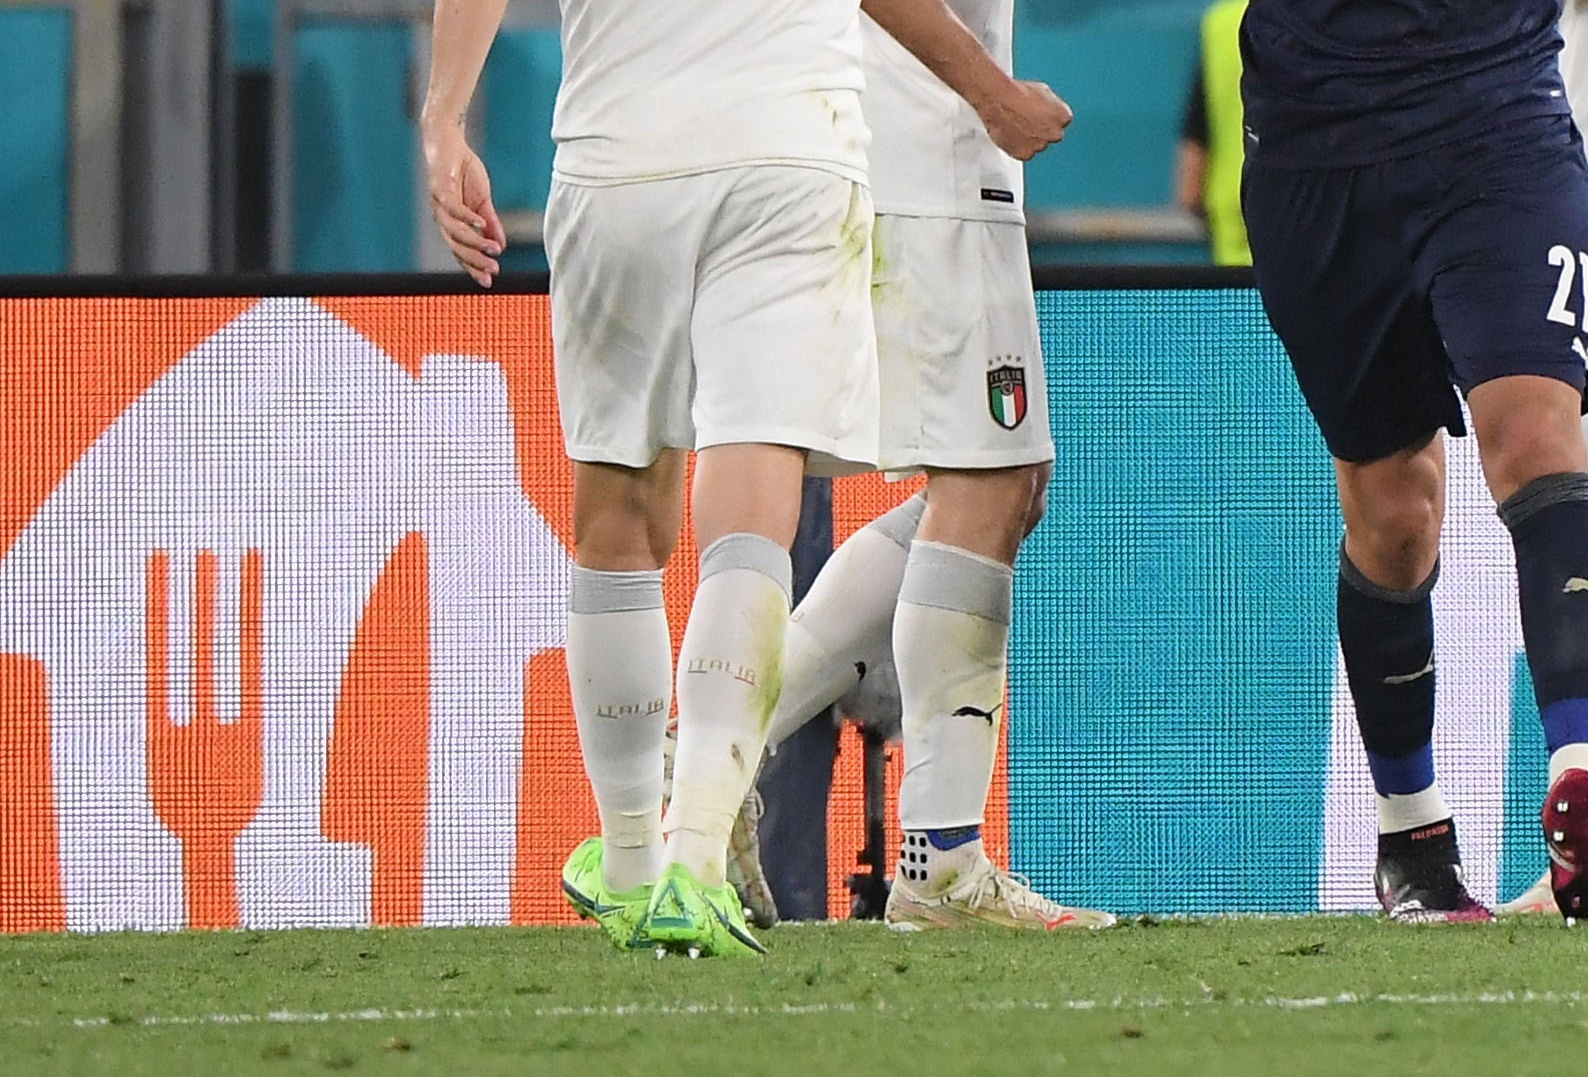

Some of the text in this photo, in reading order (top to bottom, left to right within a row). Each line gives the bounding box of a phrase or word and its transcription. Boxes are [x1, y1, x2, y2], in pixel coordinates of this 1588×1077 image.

[989, 370, 1022, 383] ITALIA
[688, 659, 757, 686] ITALIA
[597, 699, 665, 720] ITALIA
